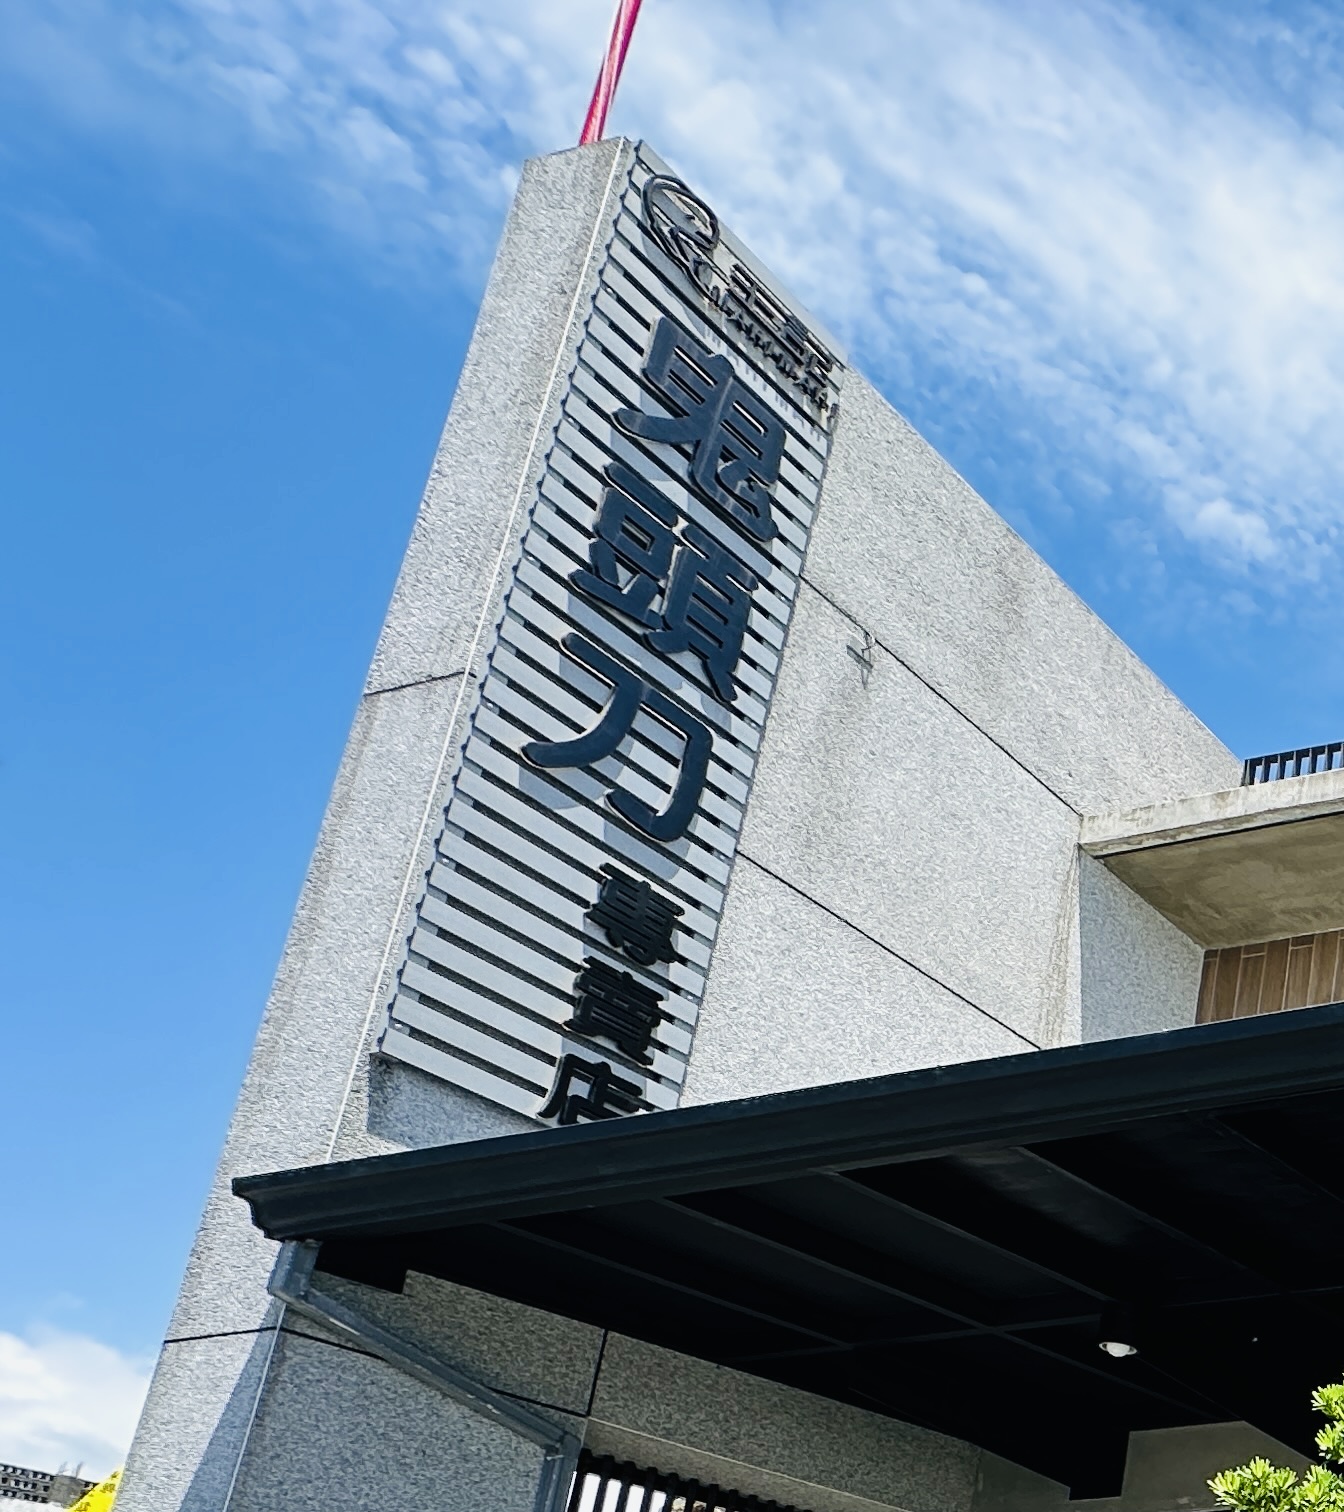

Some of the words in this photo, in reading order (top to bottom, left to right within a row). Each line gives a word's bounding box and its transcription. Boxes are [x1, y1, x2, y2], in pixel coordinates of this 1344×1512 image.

[520, 314, 788, 842] 鬼頭刀
[535, 862, 686, 1127] 專賣店
